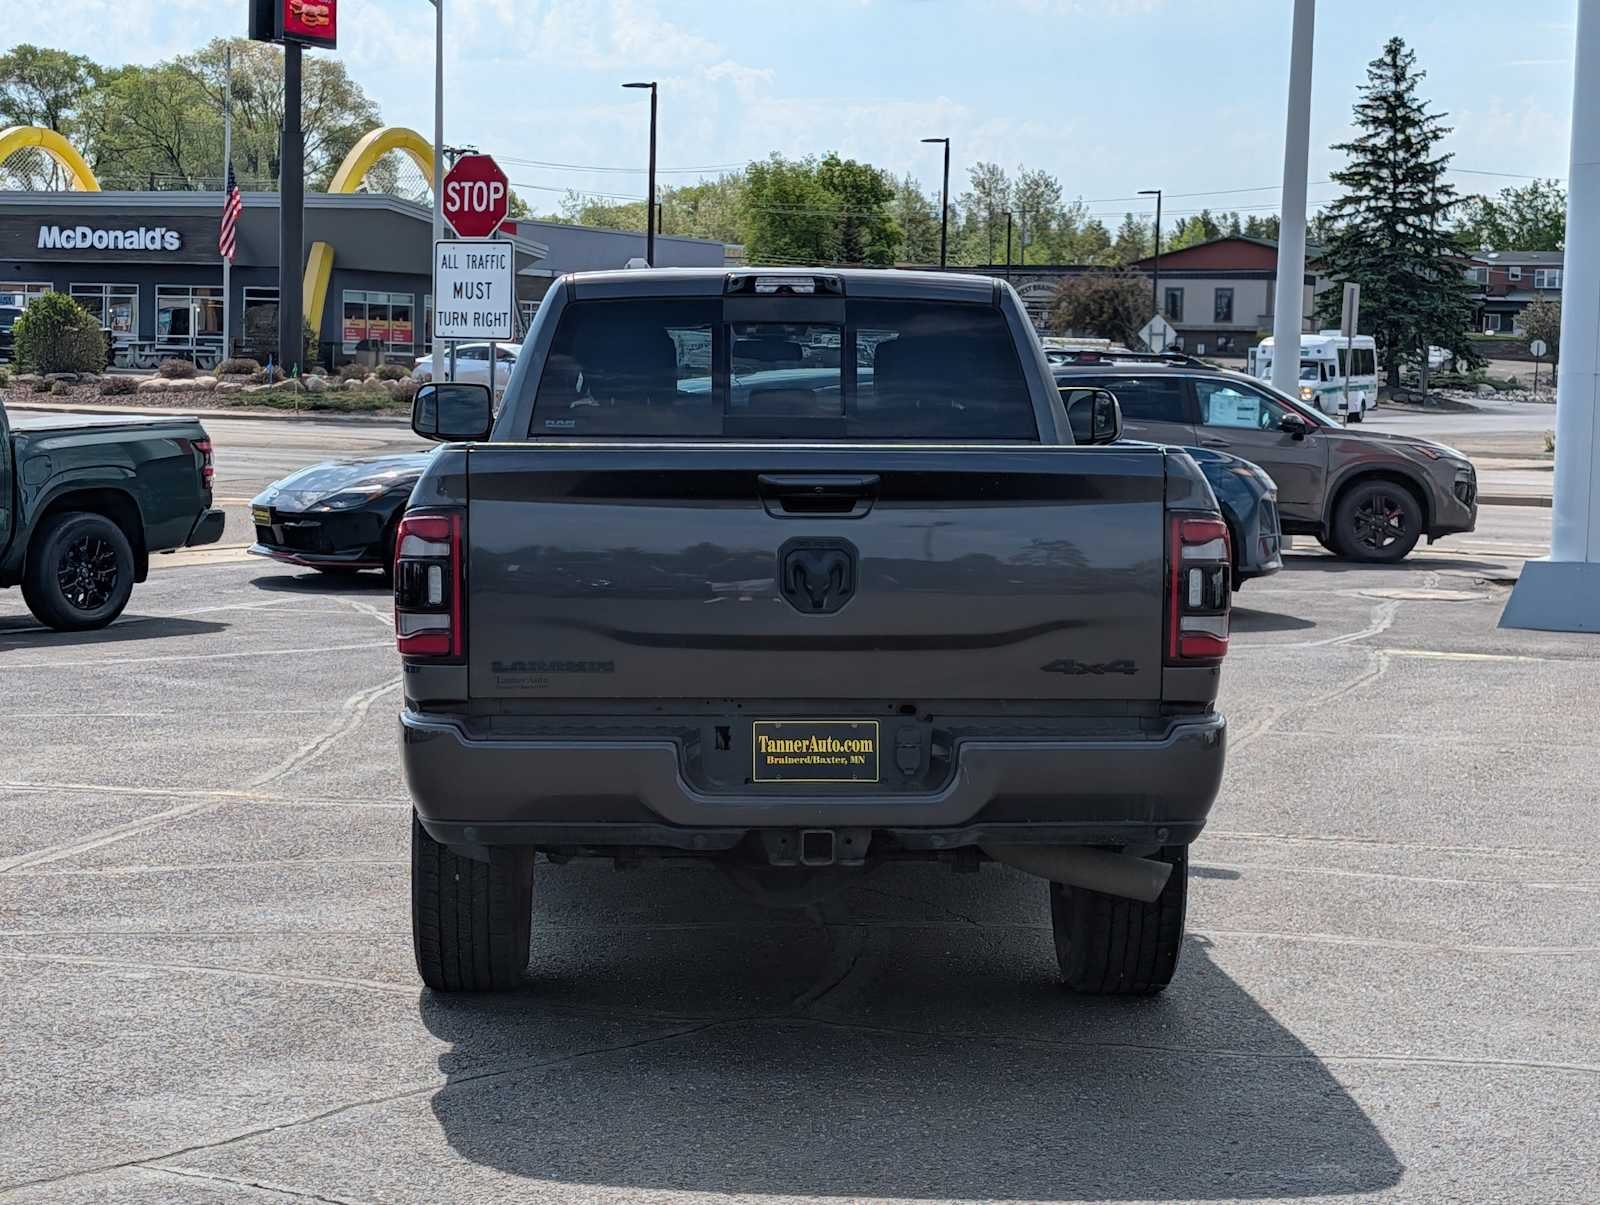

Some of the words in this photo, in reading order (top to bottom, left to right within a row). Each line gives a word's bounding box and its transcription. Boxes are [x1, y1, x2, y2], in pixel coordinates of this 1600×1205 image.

[446, 181, 504, 213] STOP
[37, 225, 181, 251] McDonald's
[441, 254, 459, 270] ALL
[466, 254, 506, 270] TRAFFIC
[453, 282, 493, 300] MUST
[438, 312, 468, 327] TURN
[473, 312, 509, 328] RIGHT
[758, 735, 874, 753] TannerAuto.com
[766, 755, 849, 765] Brainerd/Baxter,
[850, 755, 865, 764] MN
